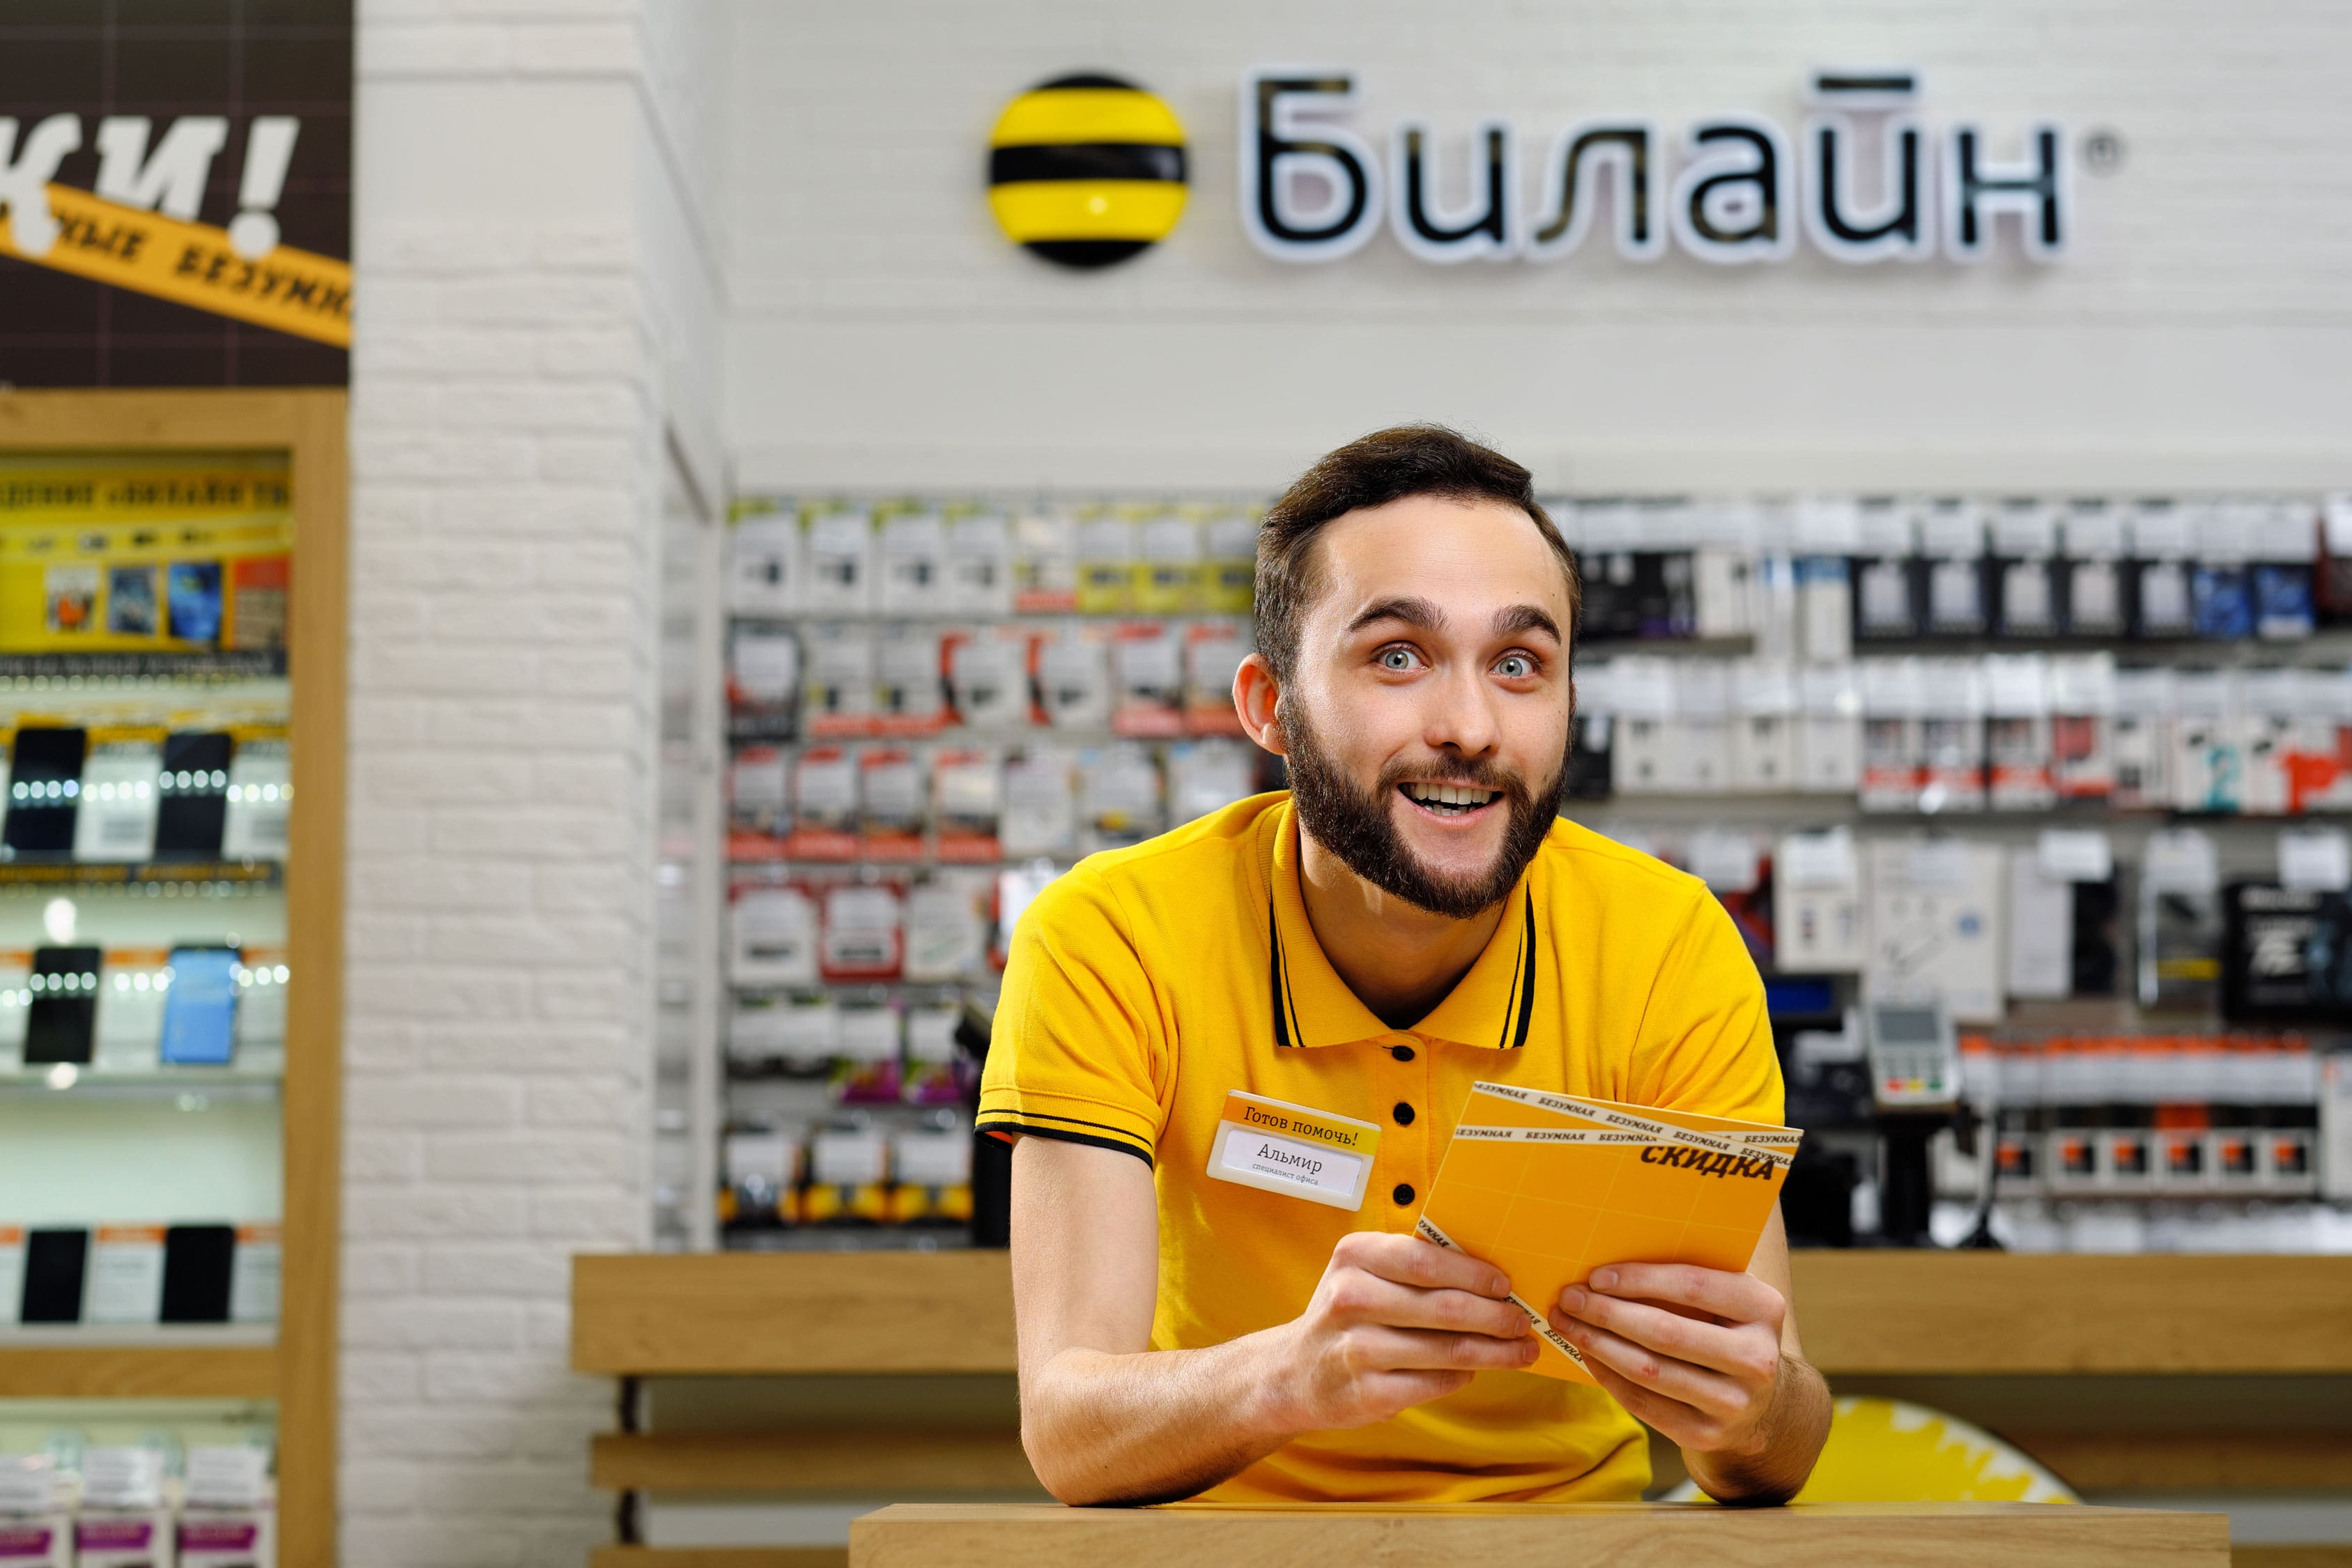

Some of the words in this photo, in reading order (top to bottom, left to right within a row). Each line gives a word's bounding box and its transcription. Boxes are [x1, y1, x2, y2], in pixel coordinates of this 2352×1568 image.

[1244, 1106, 1287, 1129] Готов
[1291, 1121, 1358, 1146] помочь!
[1525, 1131, 1586, 1141] БЕЗУМНАЯ
[1538, 1096, 1596, 1117] БЕЗУМНАЯ
[1606, 1114, 1663, 1134] БЕЗУМНАЯ
[1673, 1130, 1730, 1151] БЕЗУМНАЯ
[1740, 1147, 1791, 1166] БЕЗУМНА
[1252, 1162, 1295, 1180] специалист
[1296, 1174, 1319, 1186] офиса
[1256, 1143, 1323, 1175] Альмир
[1640, 1146, 1773, 1181] СКИДКА
